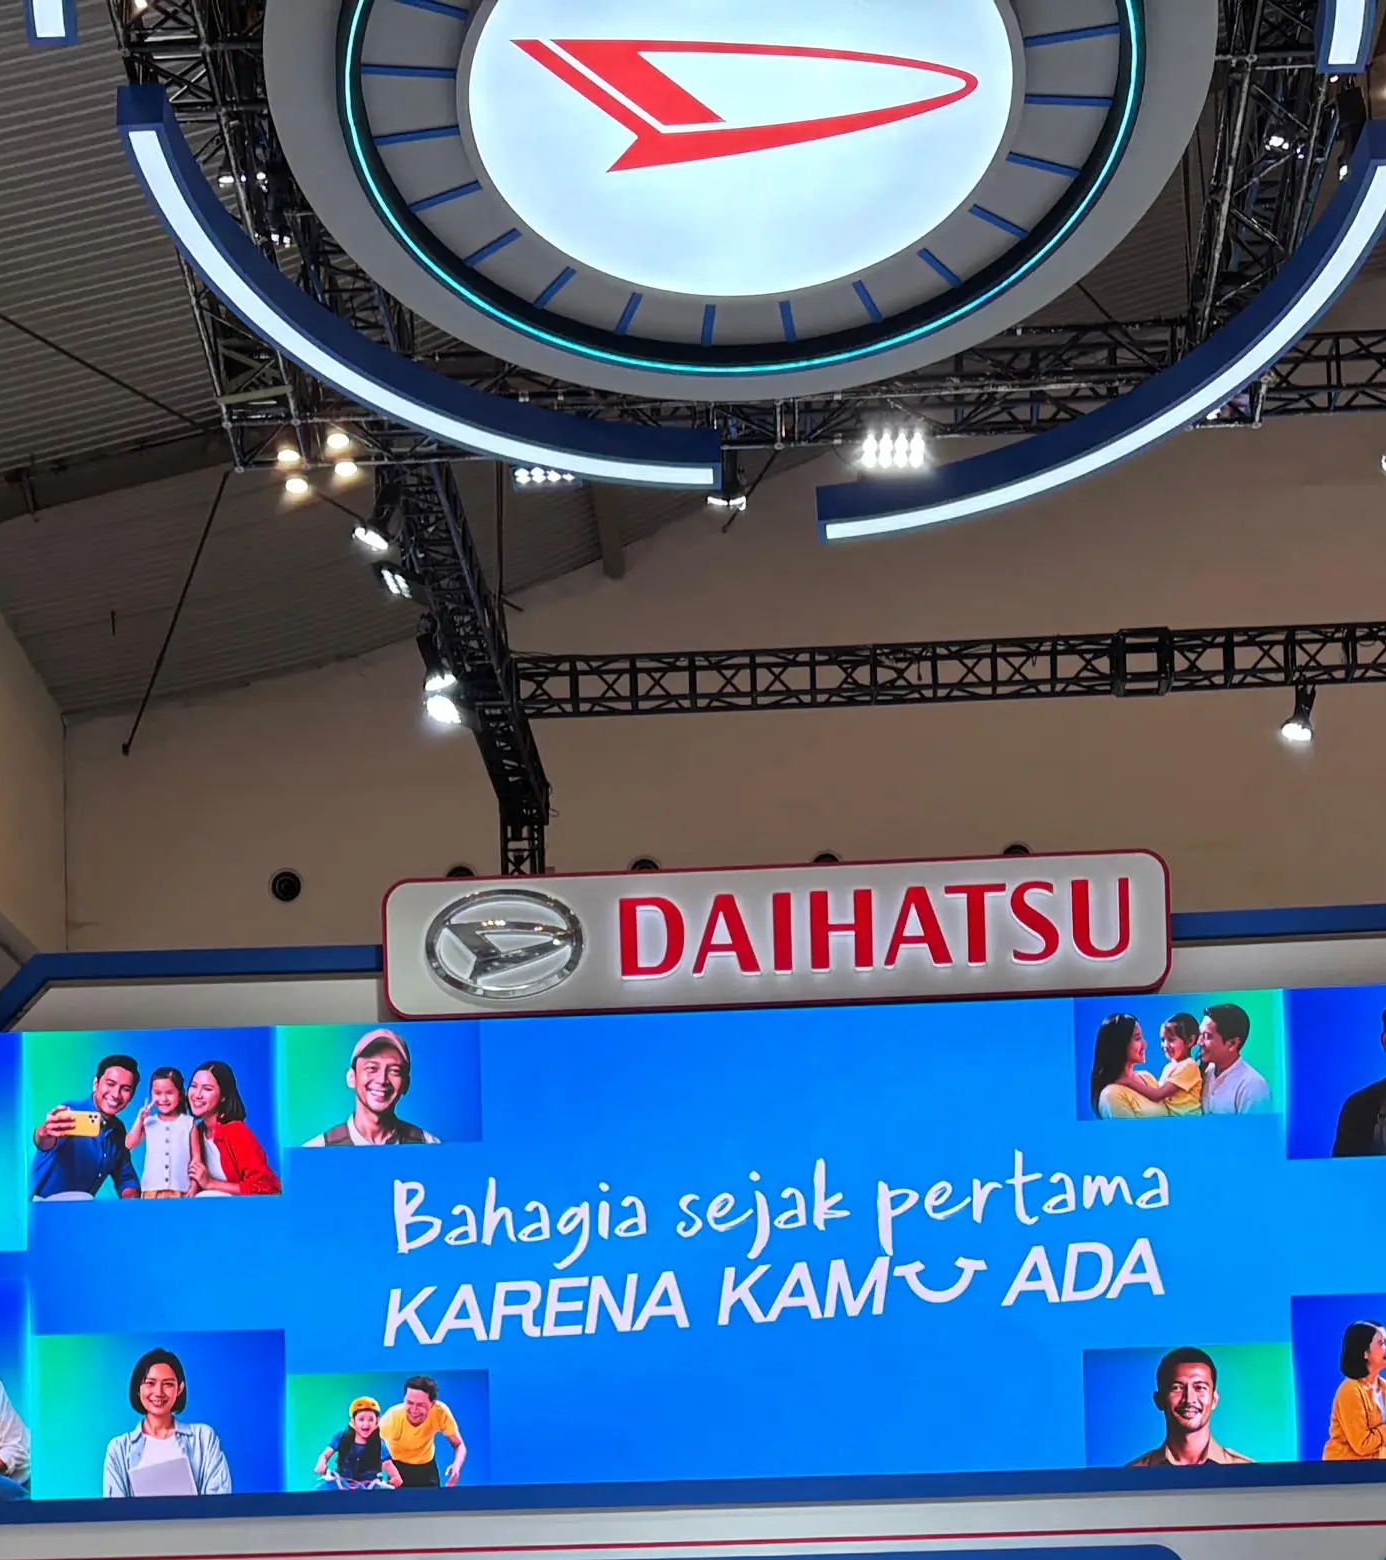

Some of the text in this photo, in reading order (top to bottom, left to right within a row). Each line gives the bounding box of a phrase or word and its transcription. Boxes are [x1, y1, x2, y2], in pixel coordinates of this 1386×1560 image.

[618, 877, 1130, 979] DAIHATSU
[393, 1150, 1171, 1269] Bahagia sejak pertama
[383, 1270, 690, 1347] KARENA
[1002, 1238, 1166, 1306] ADA
